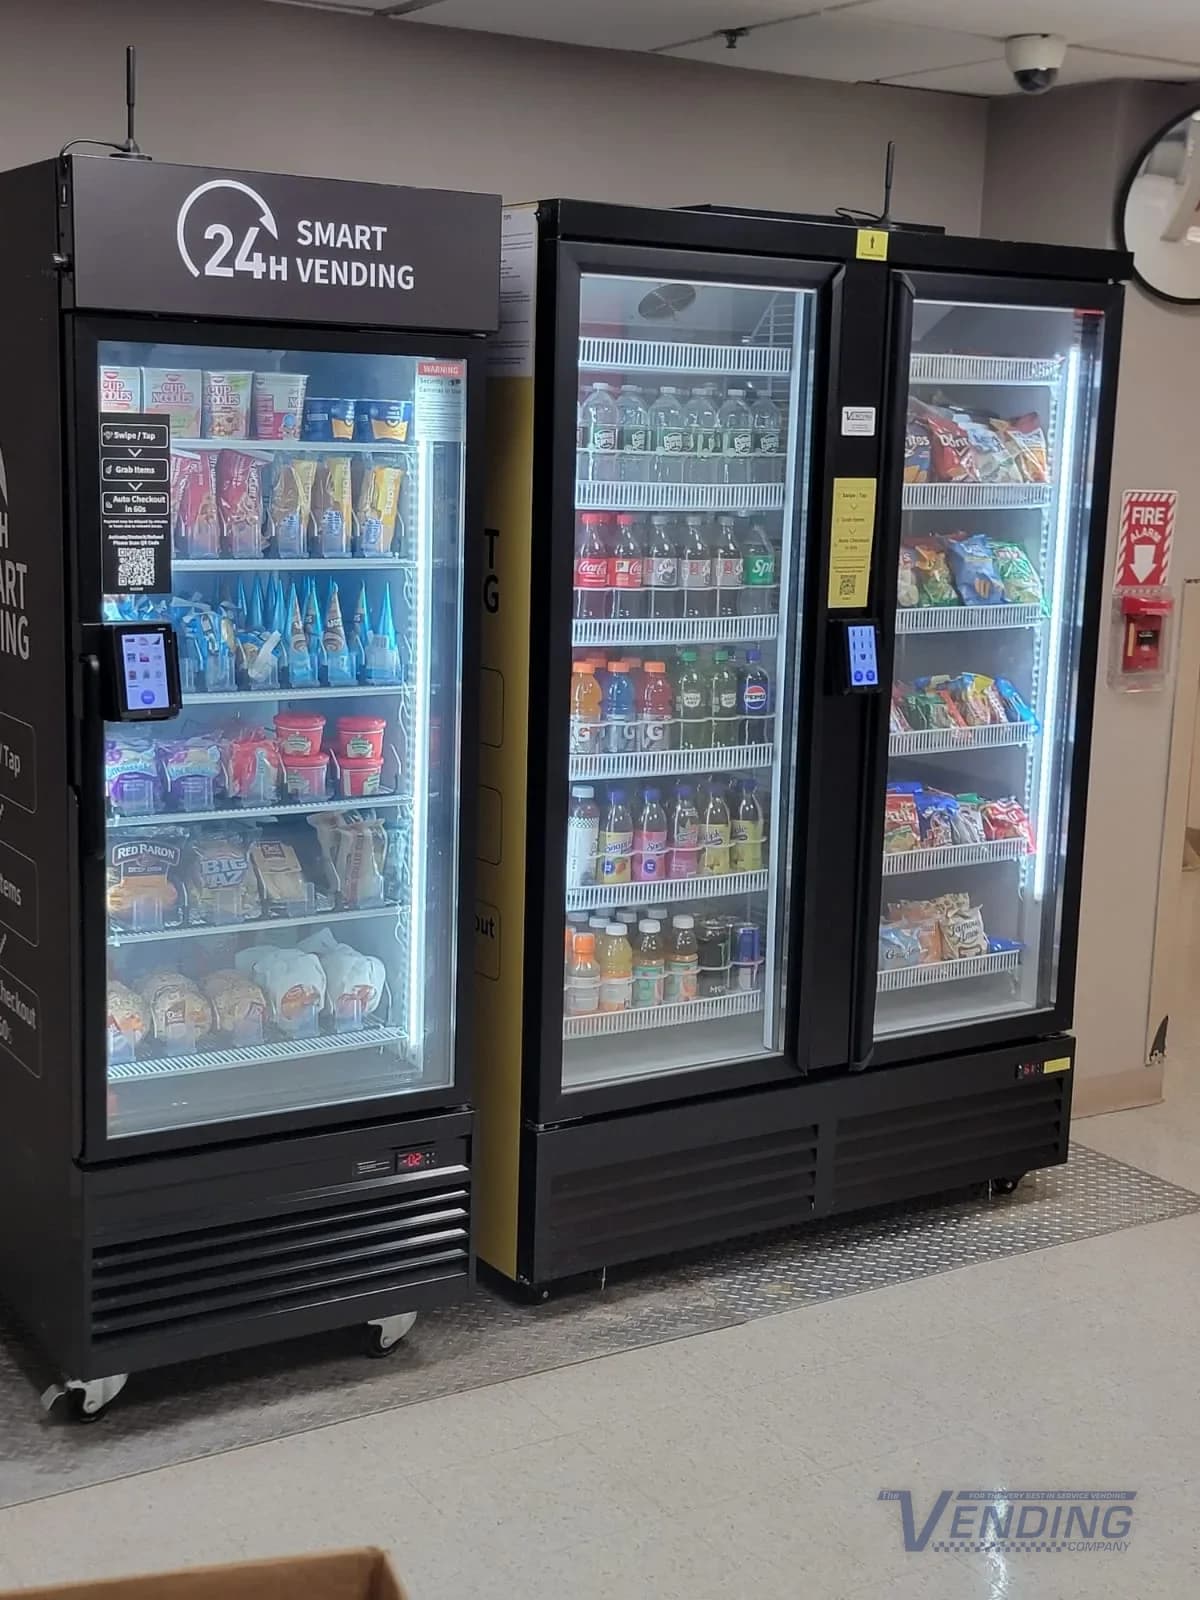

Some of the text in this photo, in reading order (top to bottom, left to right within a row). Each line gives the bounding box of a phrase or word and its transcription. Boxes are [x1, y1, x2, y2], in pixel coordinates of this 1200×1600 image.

[297, 220, 388, 251] SMART
[203, 223, 288, 281] 24H
[296, 257, 415, 290] VENDING
[423, 364, 459, 376] WARNING
[161, 382, 185, 393] CUP
[114, 431, 136, 441] Swipe
[142, 431, 156, 442] Tap
[115, 466, 156, 474] Grab Items
[113, 495, 167, 504] Auto Checkout
[1131, 507, 1166, 526] FIRE
[1130, 527, 1162, 543] ALARM
[4, 743, 21, 778] Tap
[118, 843, 176, 859] RED BARON
[201, 858, 249, 873] BIG
